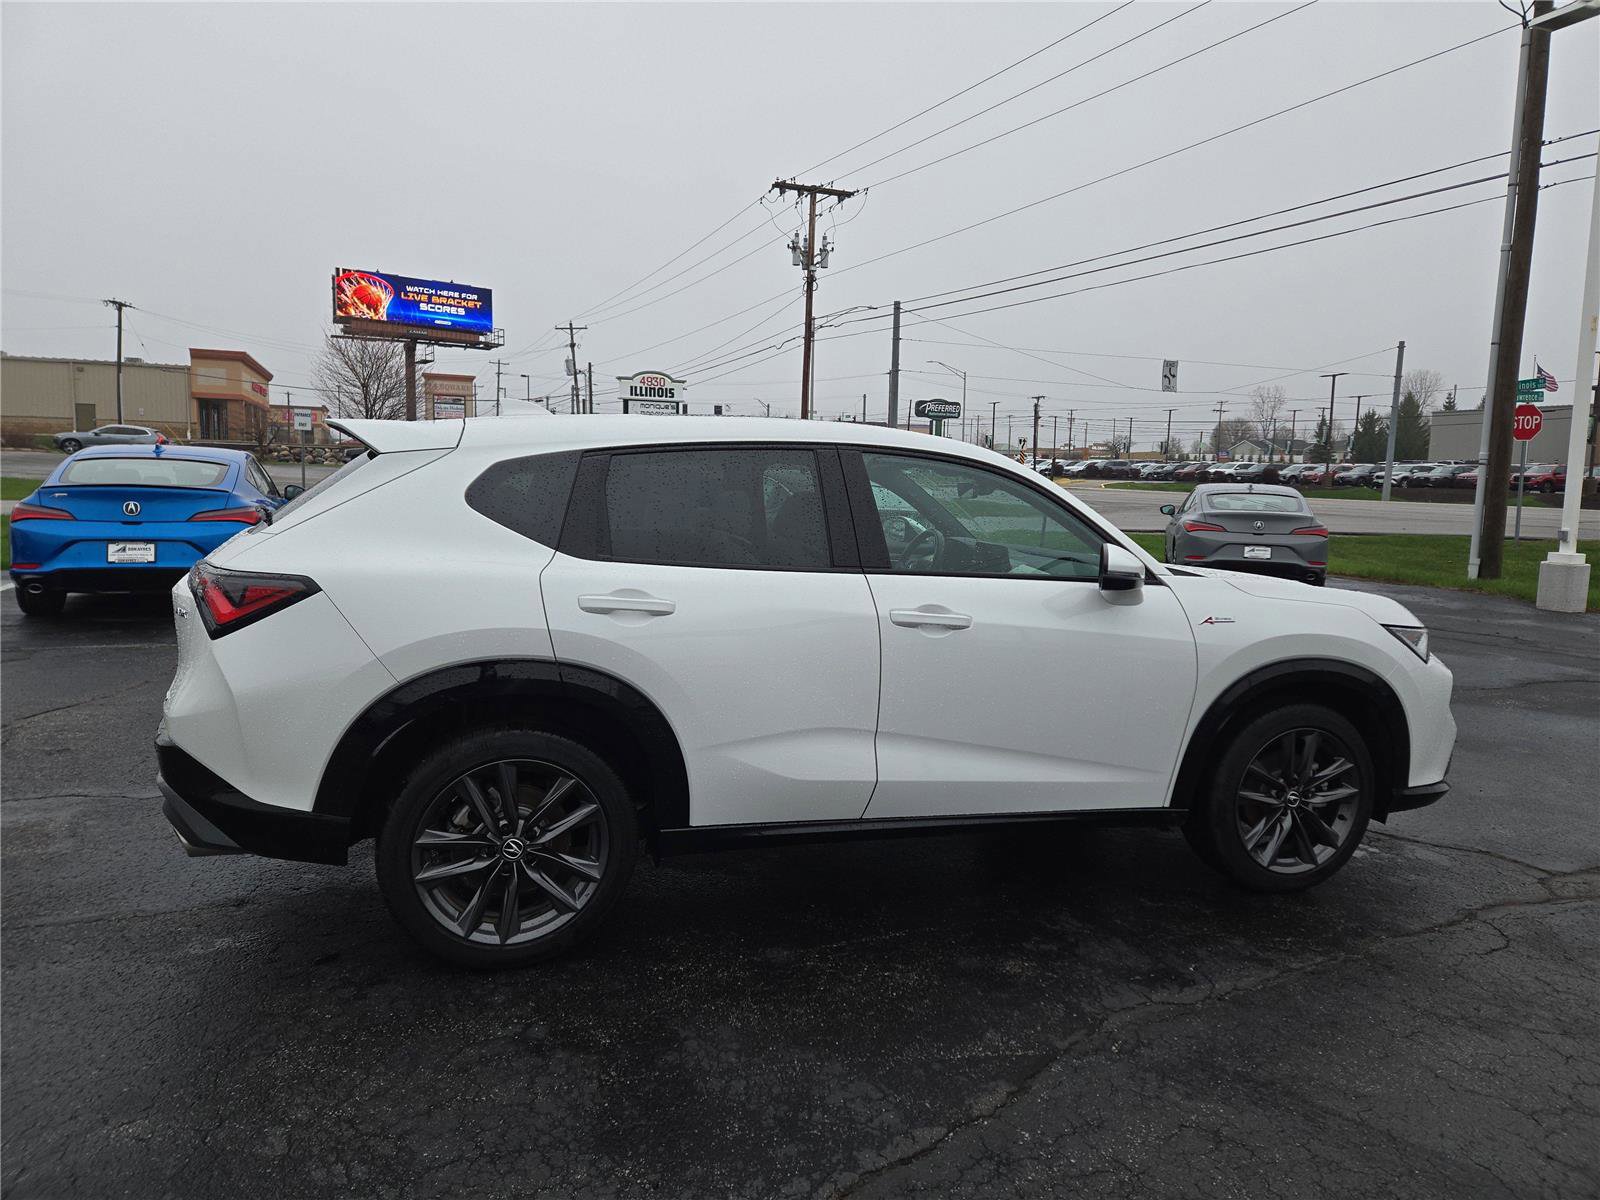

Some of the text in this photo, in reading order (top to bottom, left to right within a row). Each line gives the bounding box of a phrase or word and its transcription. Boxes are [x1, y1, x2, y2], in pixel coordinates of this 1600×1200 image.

[406, 285, 435, 295] WATCH
[437, 289, 459, 298] HERE
[401, 291, 482, 309] LIVE BRACKET
[419, 302, 466, 315] SCORES
[639, 376, 666, 387] 4930
[629, 386, 675, 398] ILLINOIS
[924, 402, 960, 414] PREFERRED
